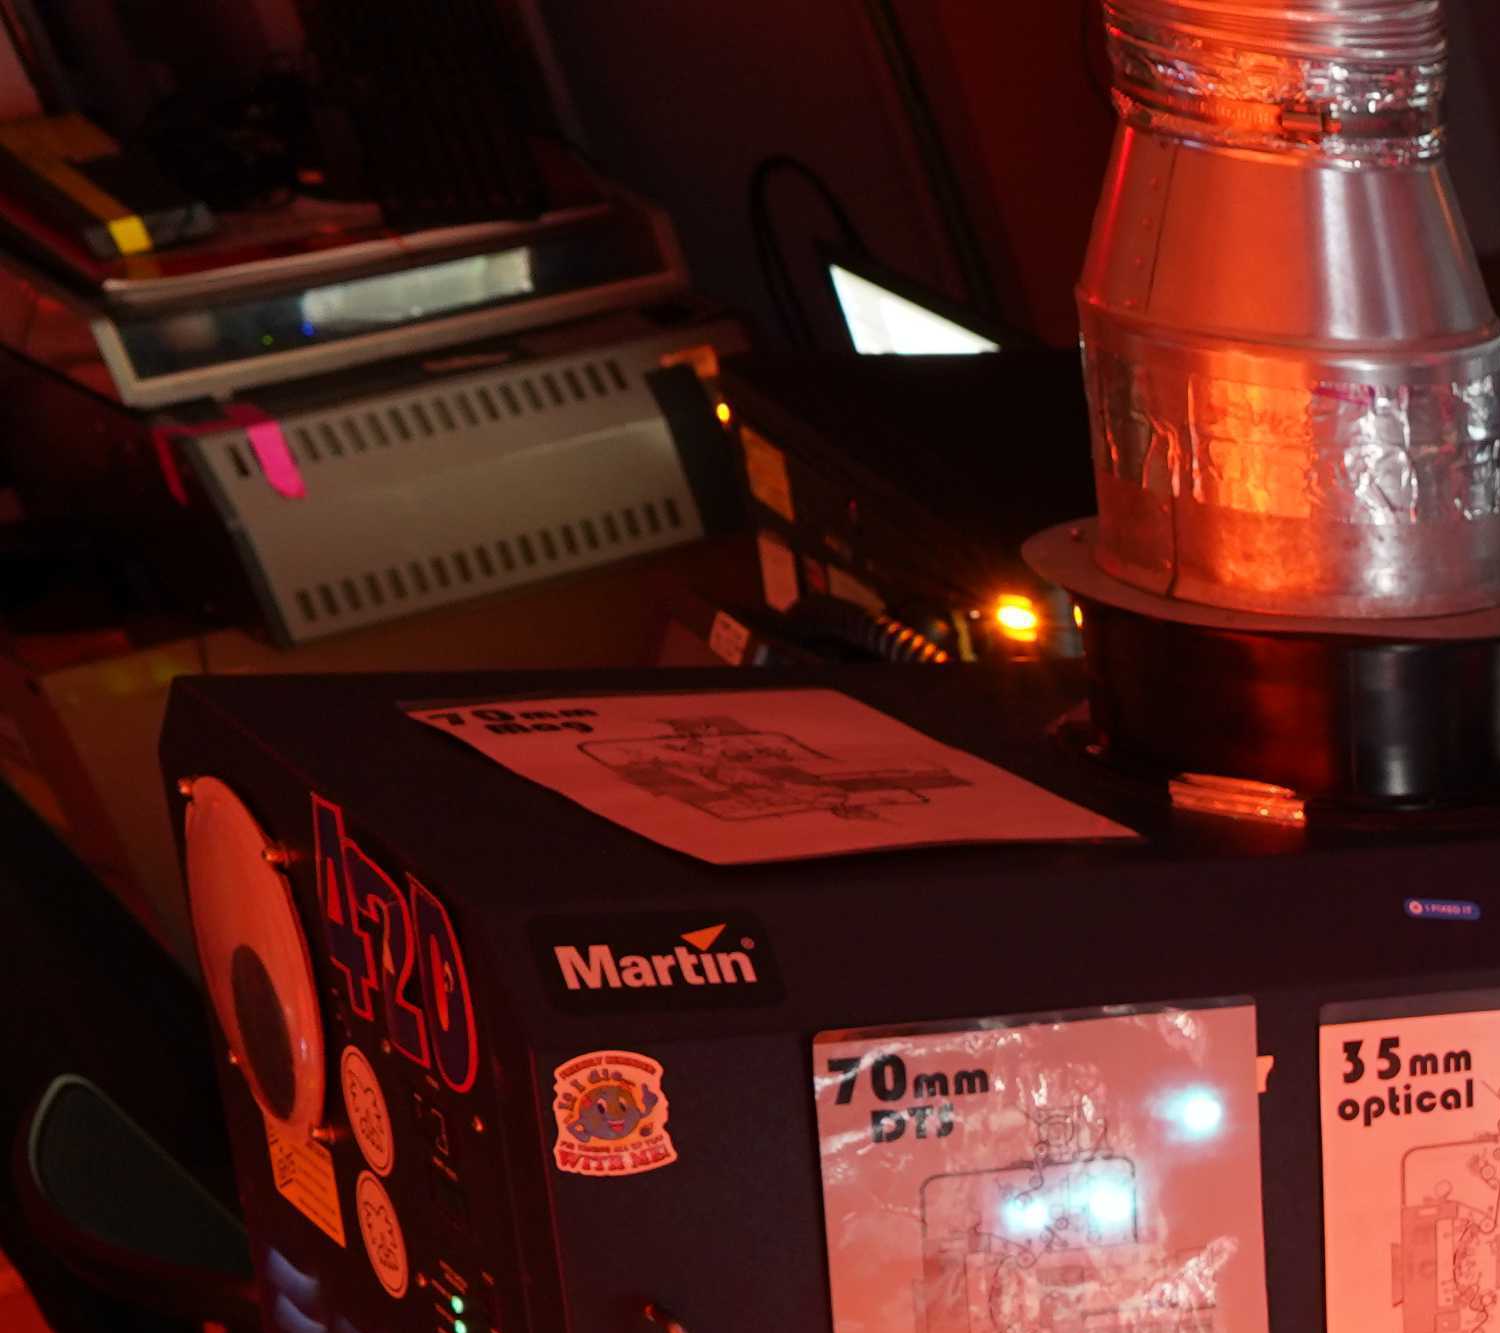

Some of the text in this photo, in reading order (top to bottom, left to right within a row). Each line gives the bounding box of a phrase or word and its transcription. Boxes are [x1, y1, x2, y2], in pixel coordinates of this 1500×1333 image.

[427, 708, 598, 726] 70mm
[484, 721, 594, 735] Mag
[310, 791, 479, 1094] 420
[554, 942, 758, 991] Martin
[827, 1054, 990, 1105] 70mm
[1342, 1036, 1472, 1084] 35mm
[1337, 1078, 1474, 1127] optical
